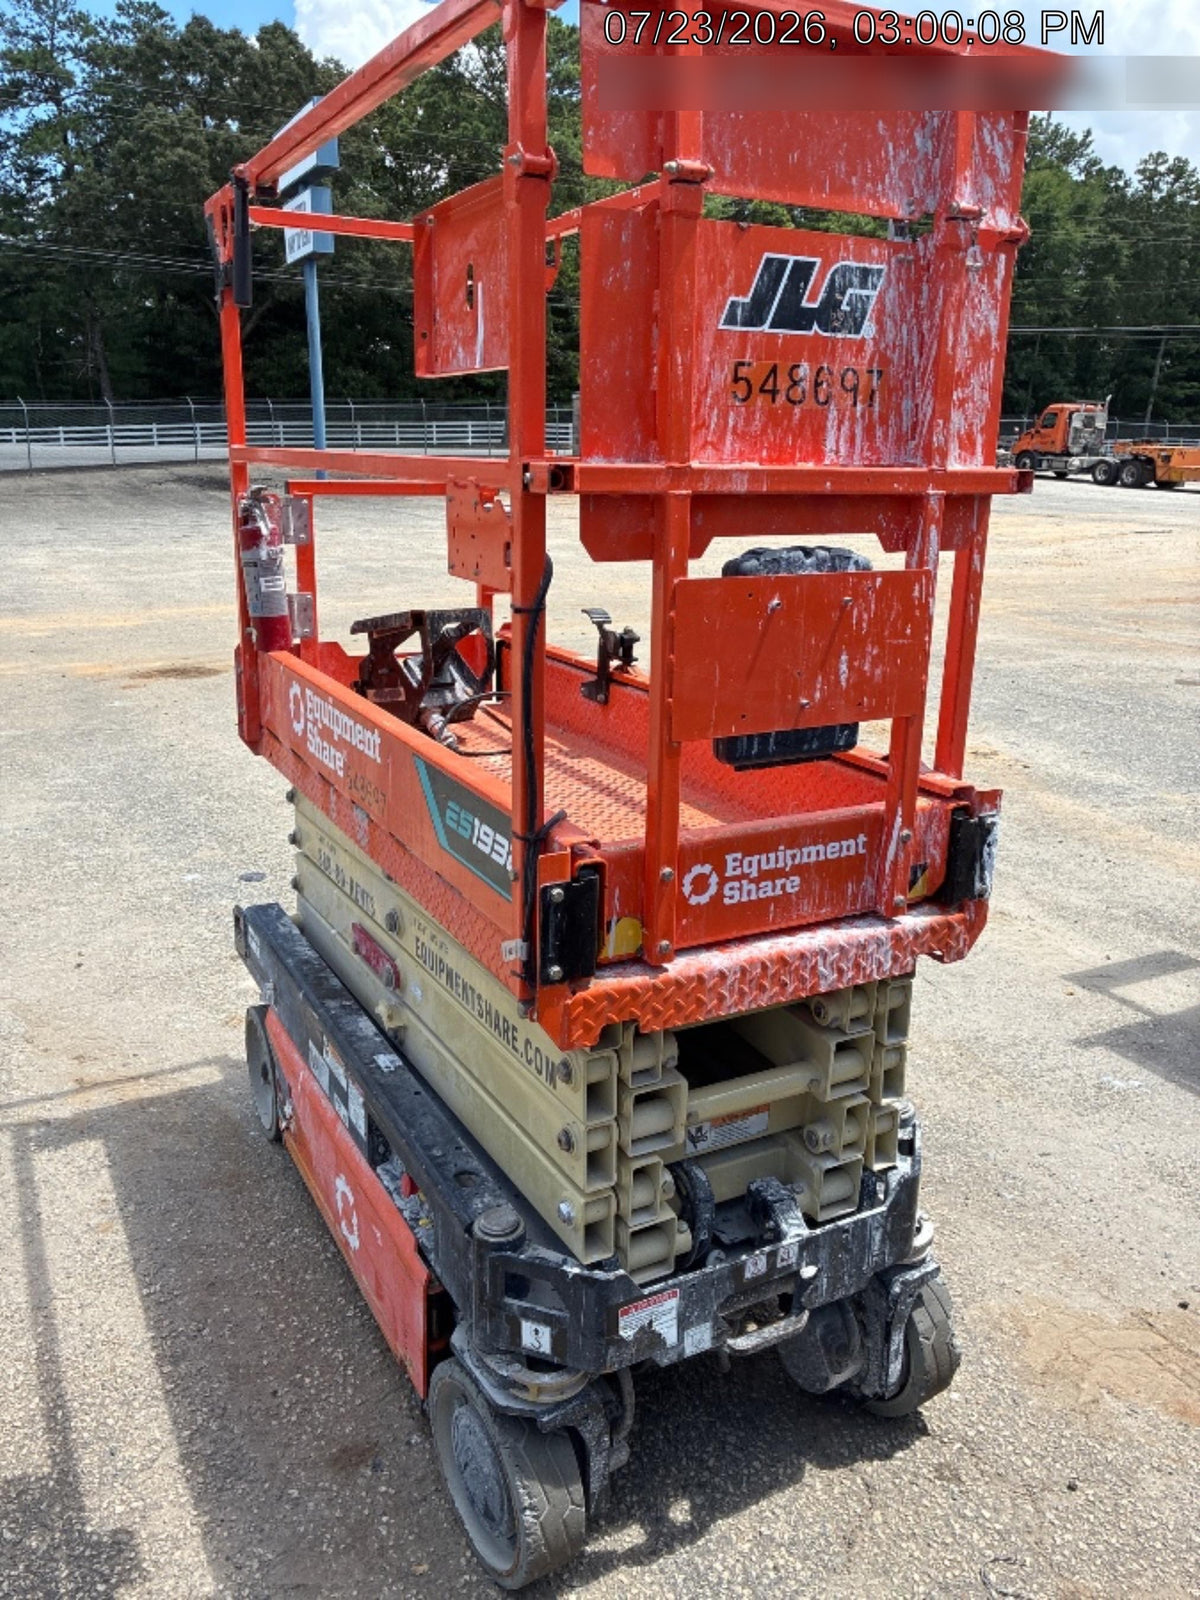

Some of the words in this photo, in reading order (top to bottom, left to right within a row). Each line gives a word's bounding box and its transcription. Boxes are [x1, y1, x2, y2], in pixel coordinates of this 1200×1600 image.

[718, 252, 887, 338] JLG
[731, 360, 884, 408] 548697
[304, 686, 381, 764] Equipment
[306, 727, 345, 778] Share
[445, 801, 513, 872] ES193
[725, 833, 868, 878] Equipment
[722, 876, 801, 906] Share
[414, 935, 558, 1090] EQUIPMENTSHARE.COM
